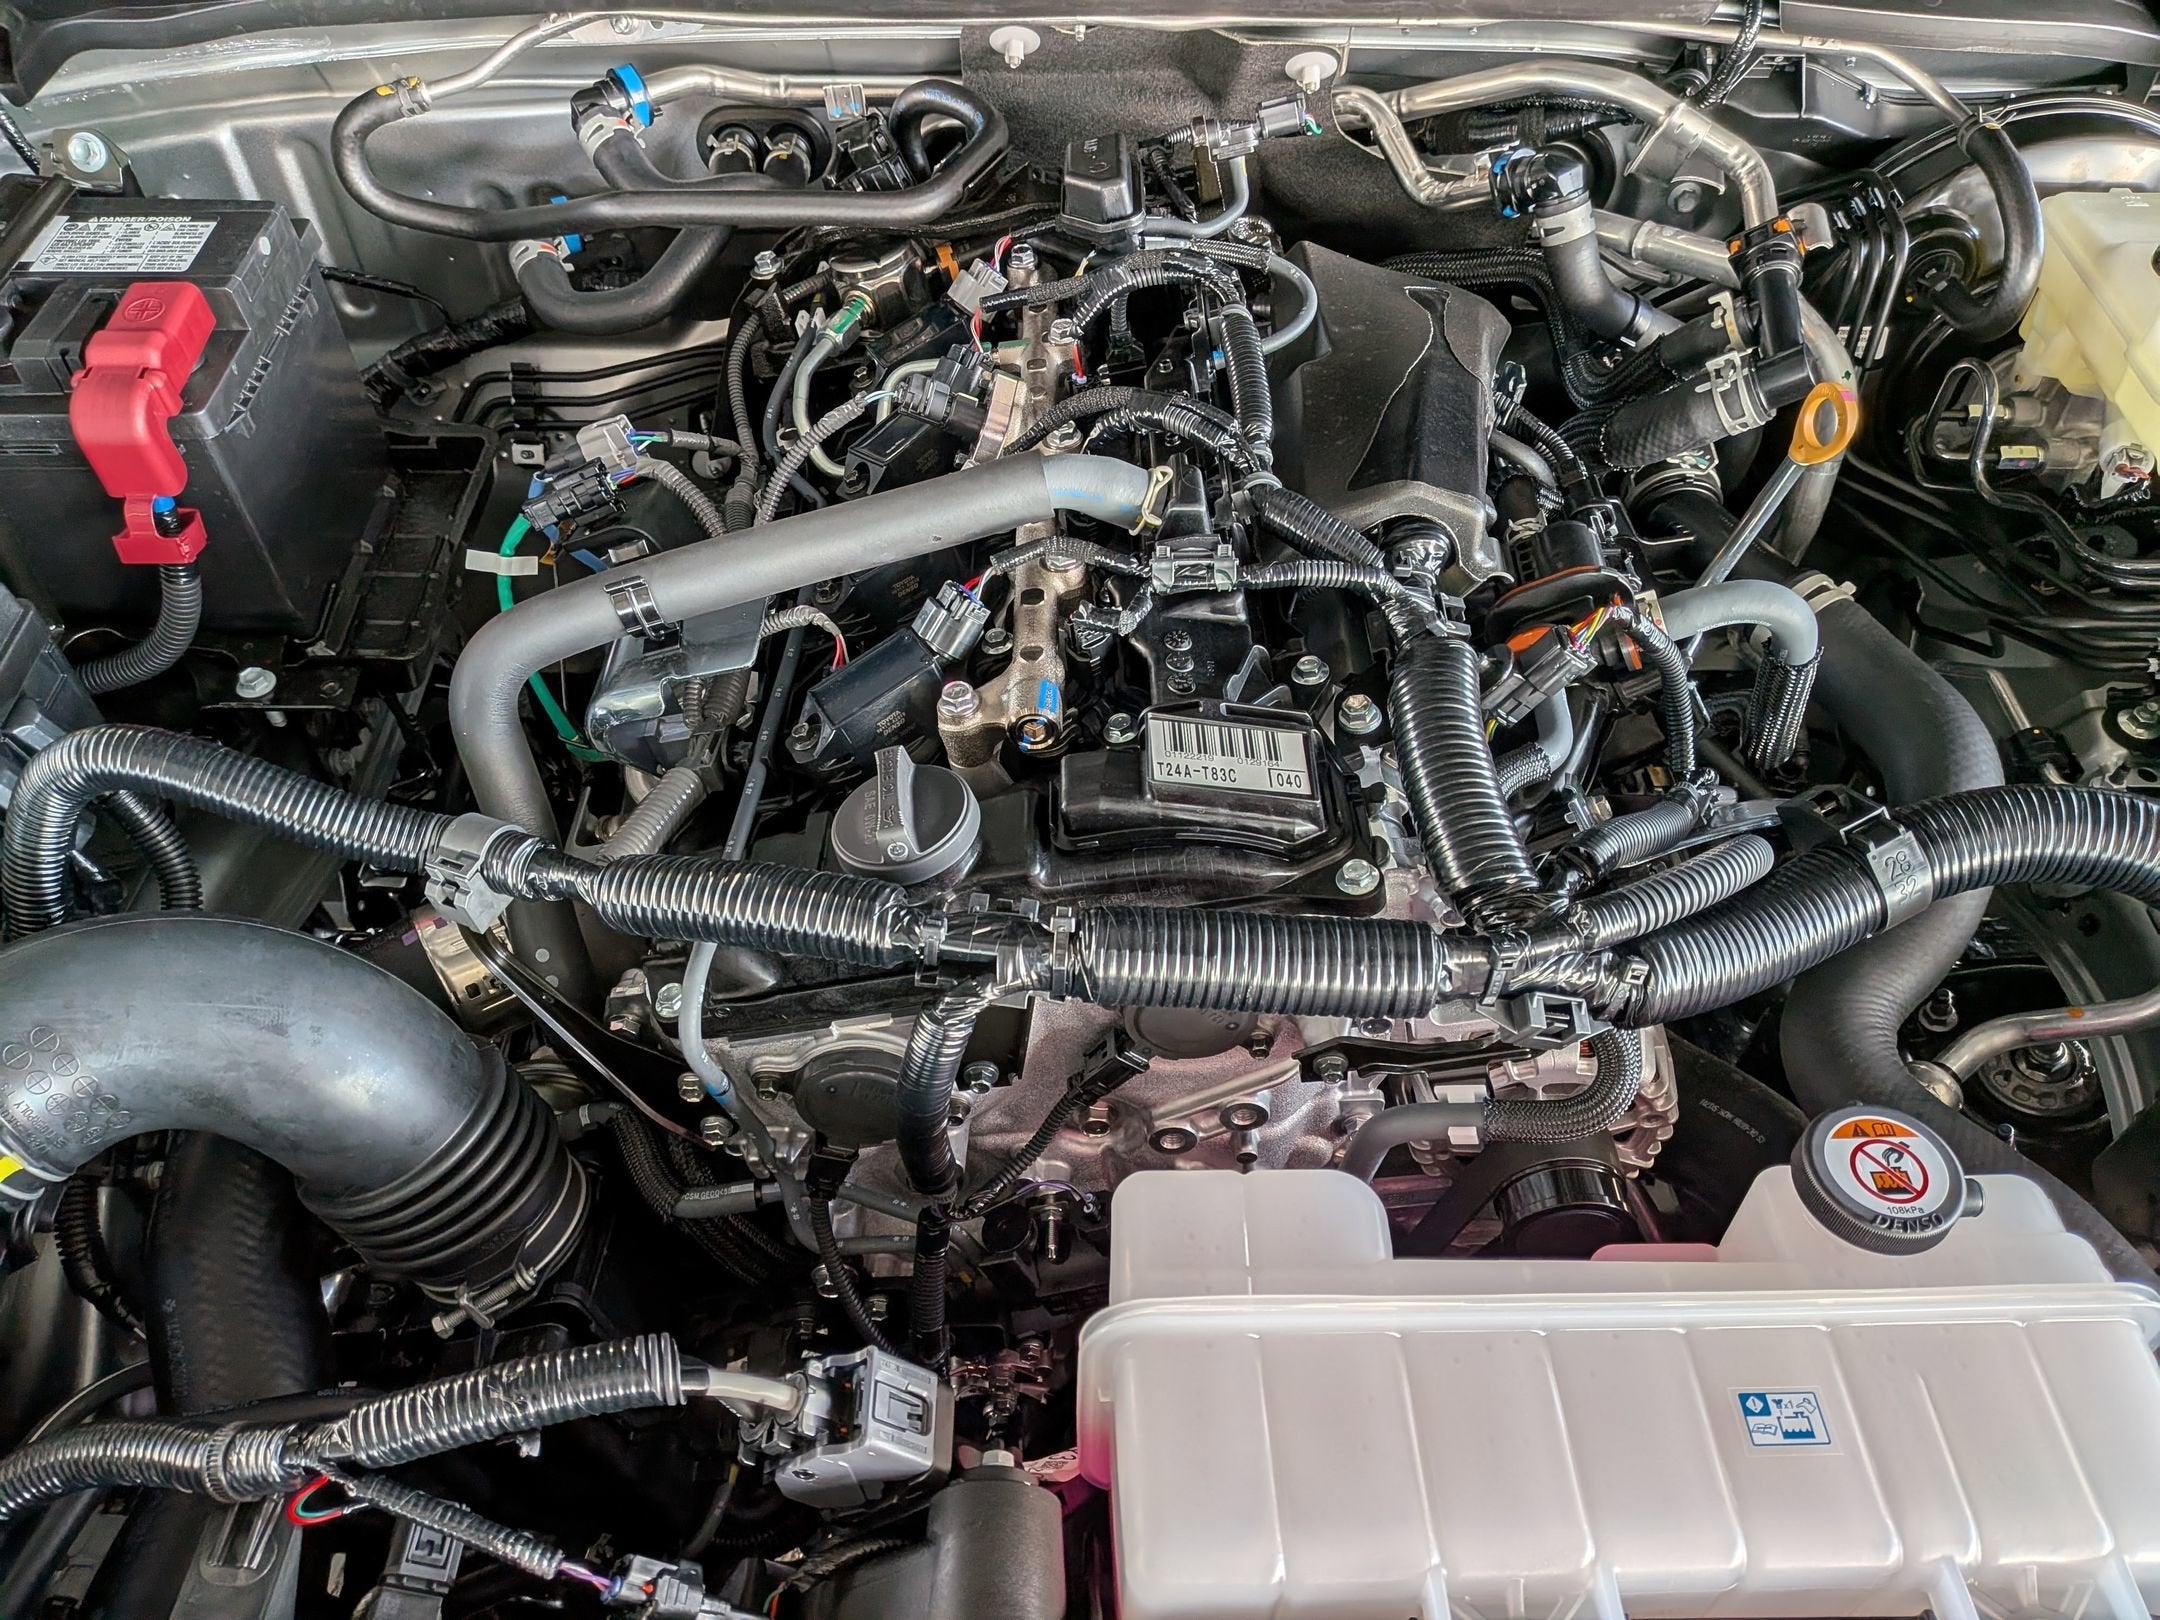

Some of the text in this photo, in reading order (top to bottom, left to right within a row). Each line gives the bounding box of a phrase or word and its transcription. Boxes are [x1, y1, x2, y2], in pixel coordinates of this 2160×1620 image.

[876, 710, 902, 727] TOYOTA
[1156, 761, 1303, 789] T24A-T83C 040
[864, 790, 877, 810] SAE
[1884, 850, 1913, 882] 28
[1894, 874, 1921, 905] 32
[1887, 1206, 1925, 1215] 108kPa
[1873, 1212, 1945, 1234] DENSO
